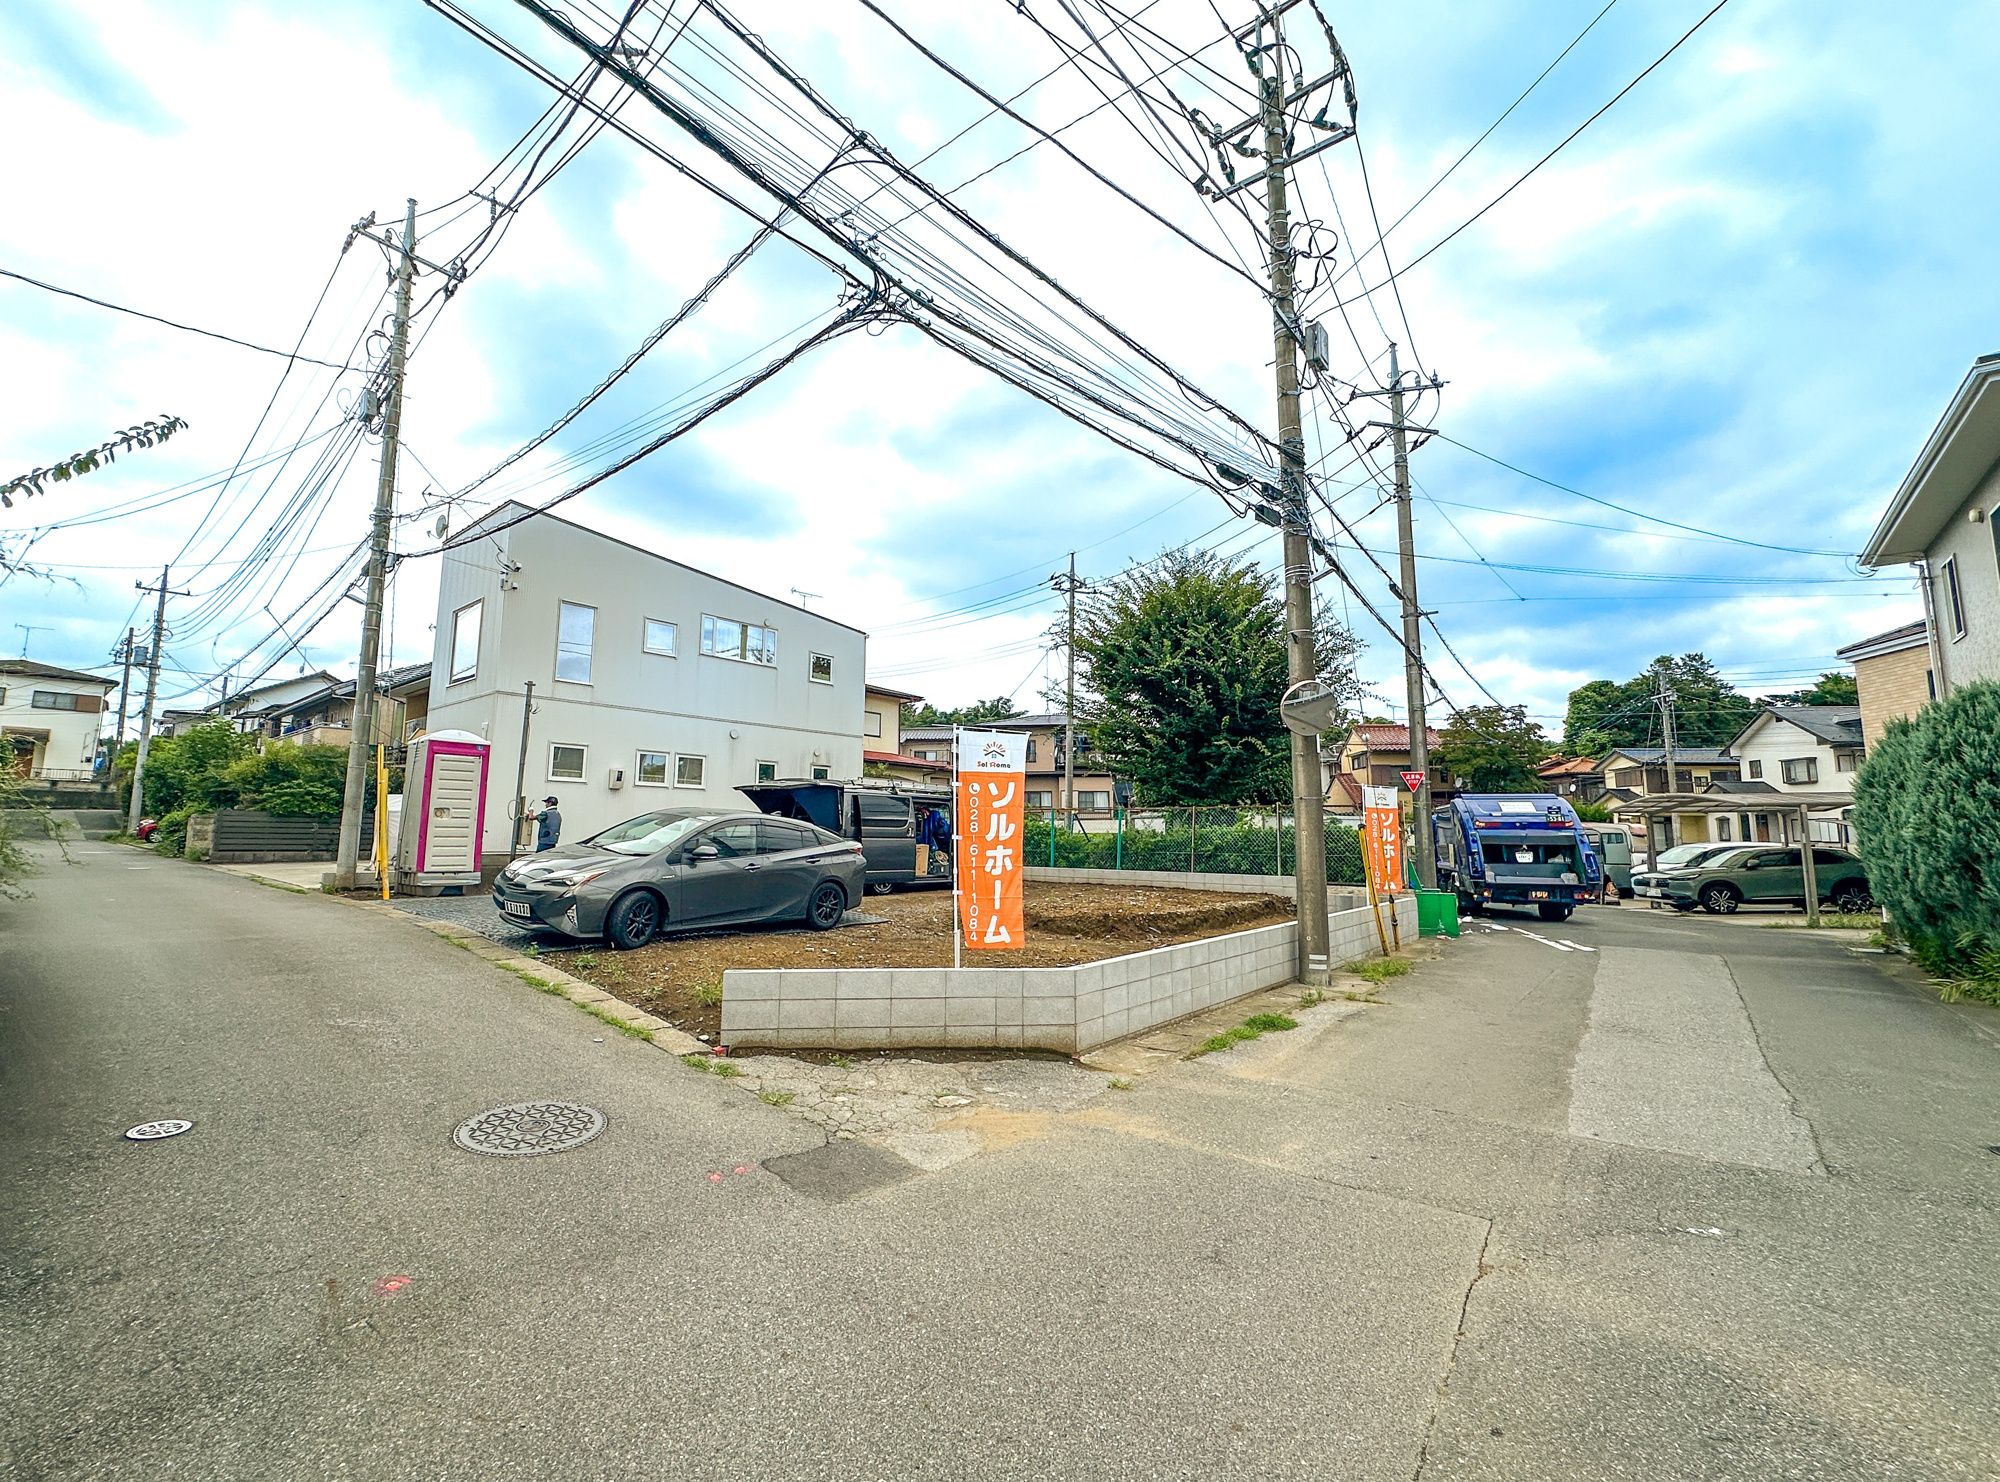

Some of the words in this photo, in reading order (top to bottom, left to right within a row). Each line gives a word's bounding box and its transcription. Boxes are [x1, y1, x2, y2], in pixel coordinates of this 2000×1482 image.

[969, 796, 979, 942] 028-611-1084
[983, 781, 1016, 944] ソルホーム
[1380, 812, 1397, 890] ソルホーム
